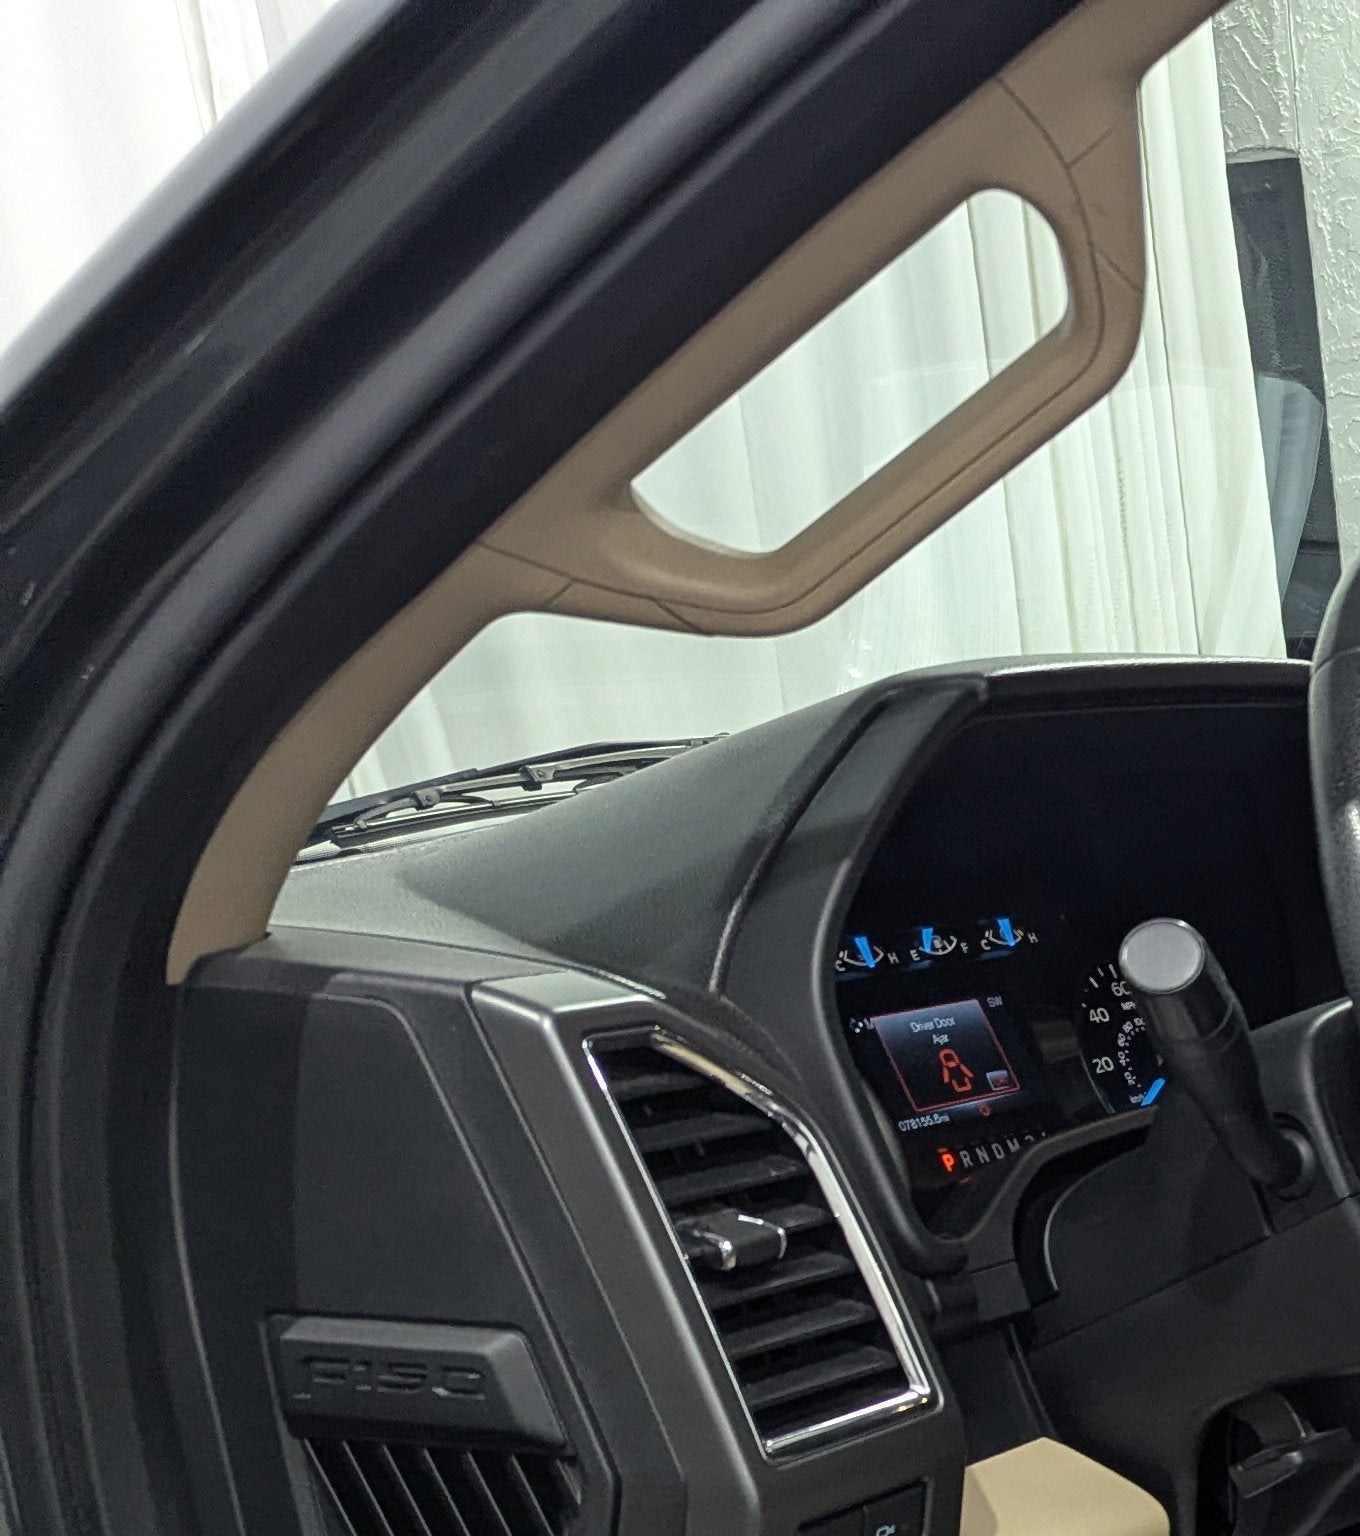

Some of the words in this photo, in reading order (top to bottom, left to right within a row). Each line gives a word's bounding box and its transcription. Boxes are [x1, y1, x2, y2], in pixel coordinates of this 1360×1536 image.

[981, 939, 991, 950] C
[1028, 932, 1039, 944] H
[887, 952, 899, 965] H
[910, 949, 920, 961] E
[960, 942, 969, 954] F
[1089, 1007, 1110, 1023] 40
[1092, 1056, 1115, 1074] 20
[941, 1152, 955, 1173] P
[959, 1150, 974, 1169] R
[975, 1144, 990, 1164] N
[991, 1142, 1005, 1160] D
